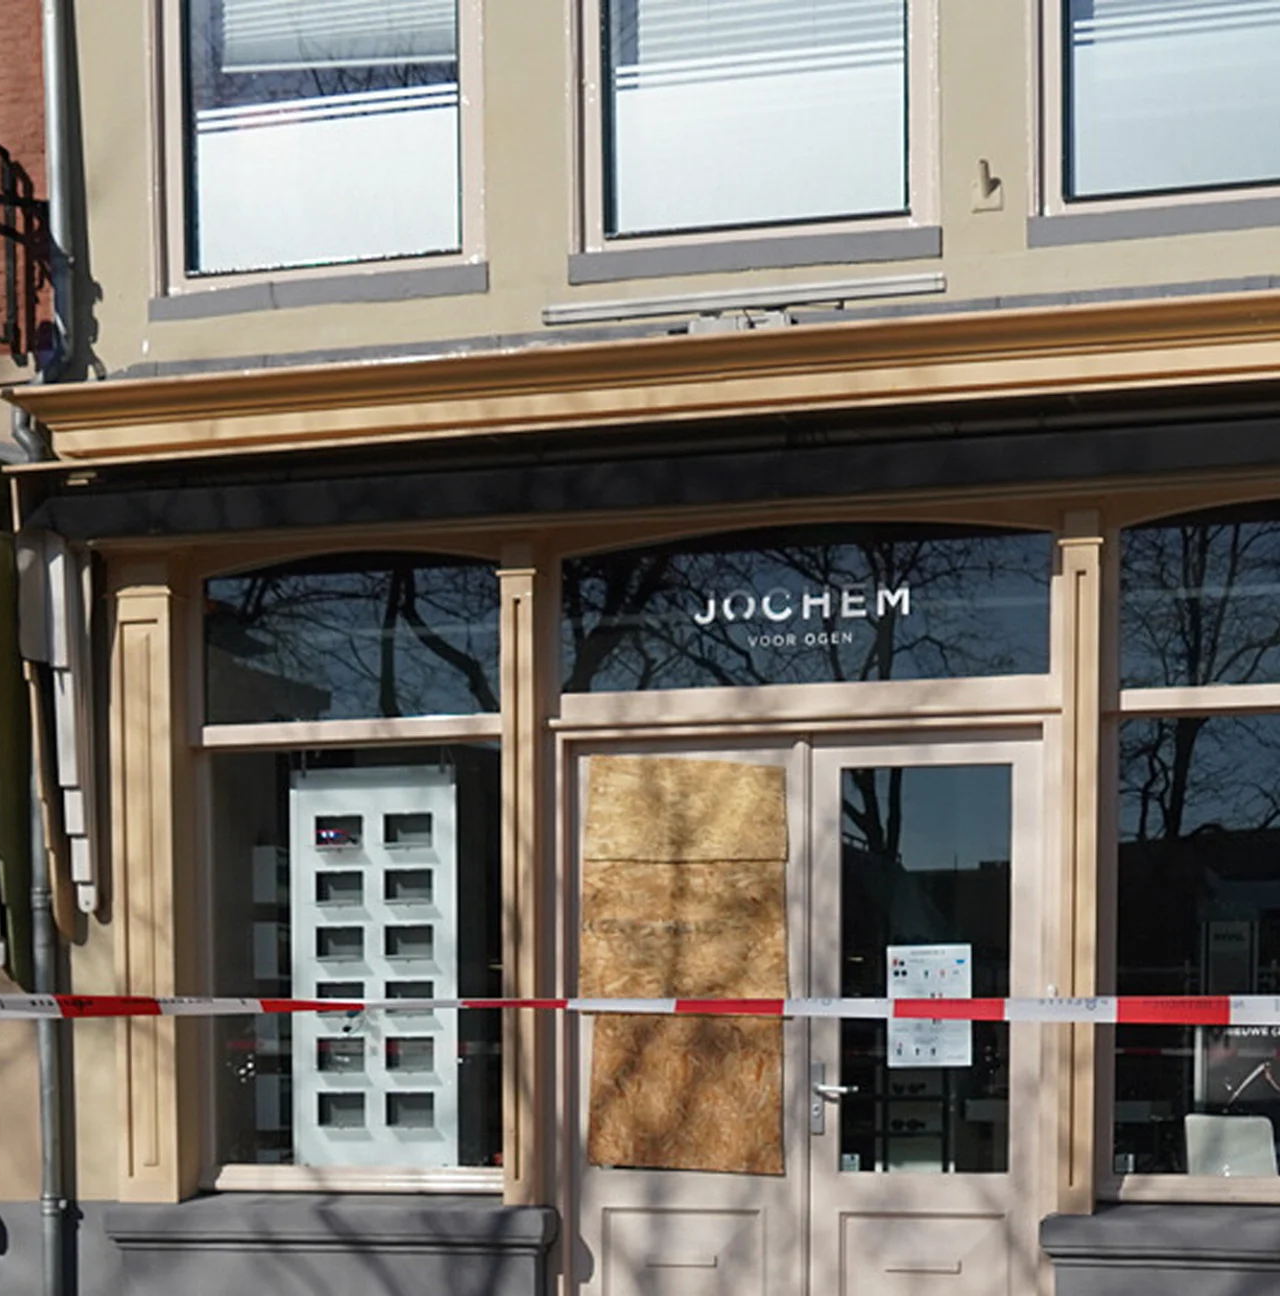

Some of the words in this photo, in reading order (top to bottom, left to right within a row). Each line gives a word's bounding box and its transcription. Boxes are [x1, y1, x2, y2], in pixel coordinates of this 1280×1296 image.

[694, 580, 910, 625] JOCHEM
[747, 633, 797, 647] VOOR
[803, 631, 853, 645] OGEN
